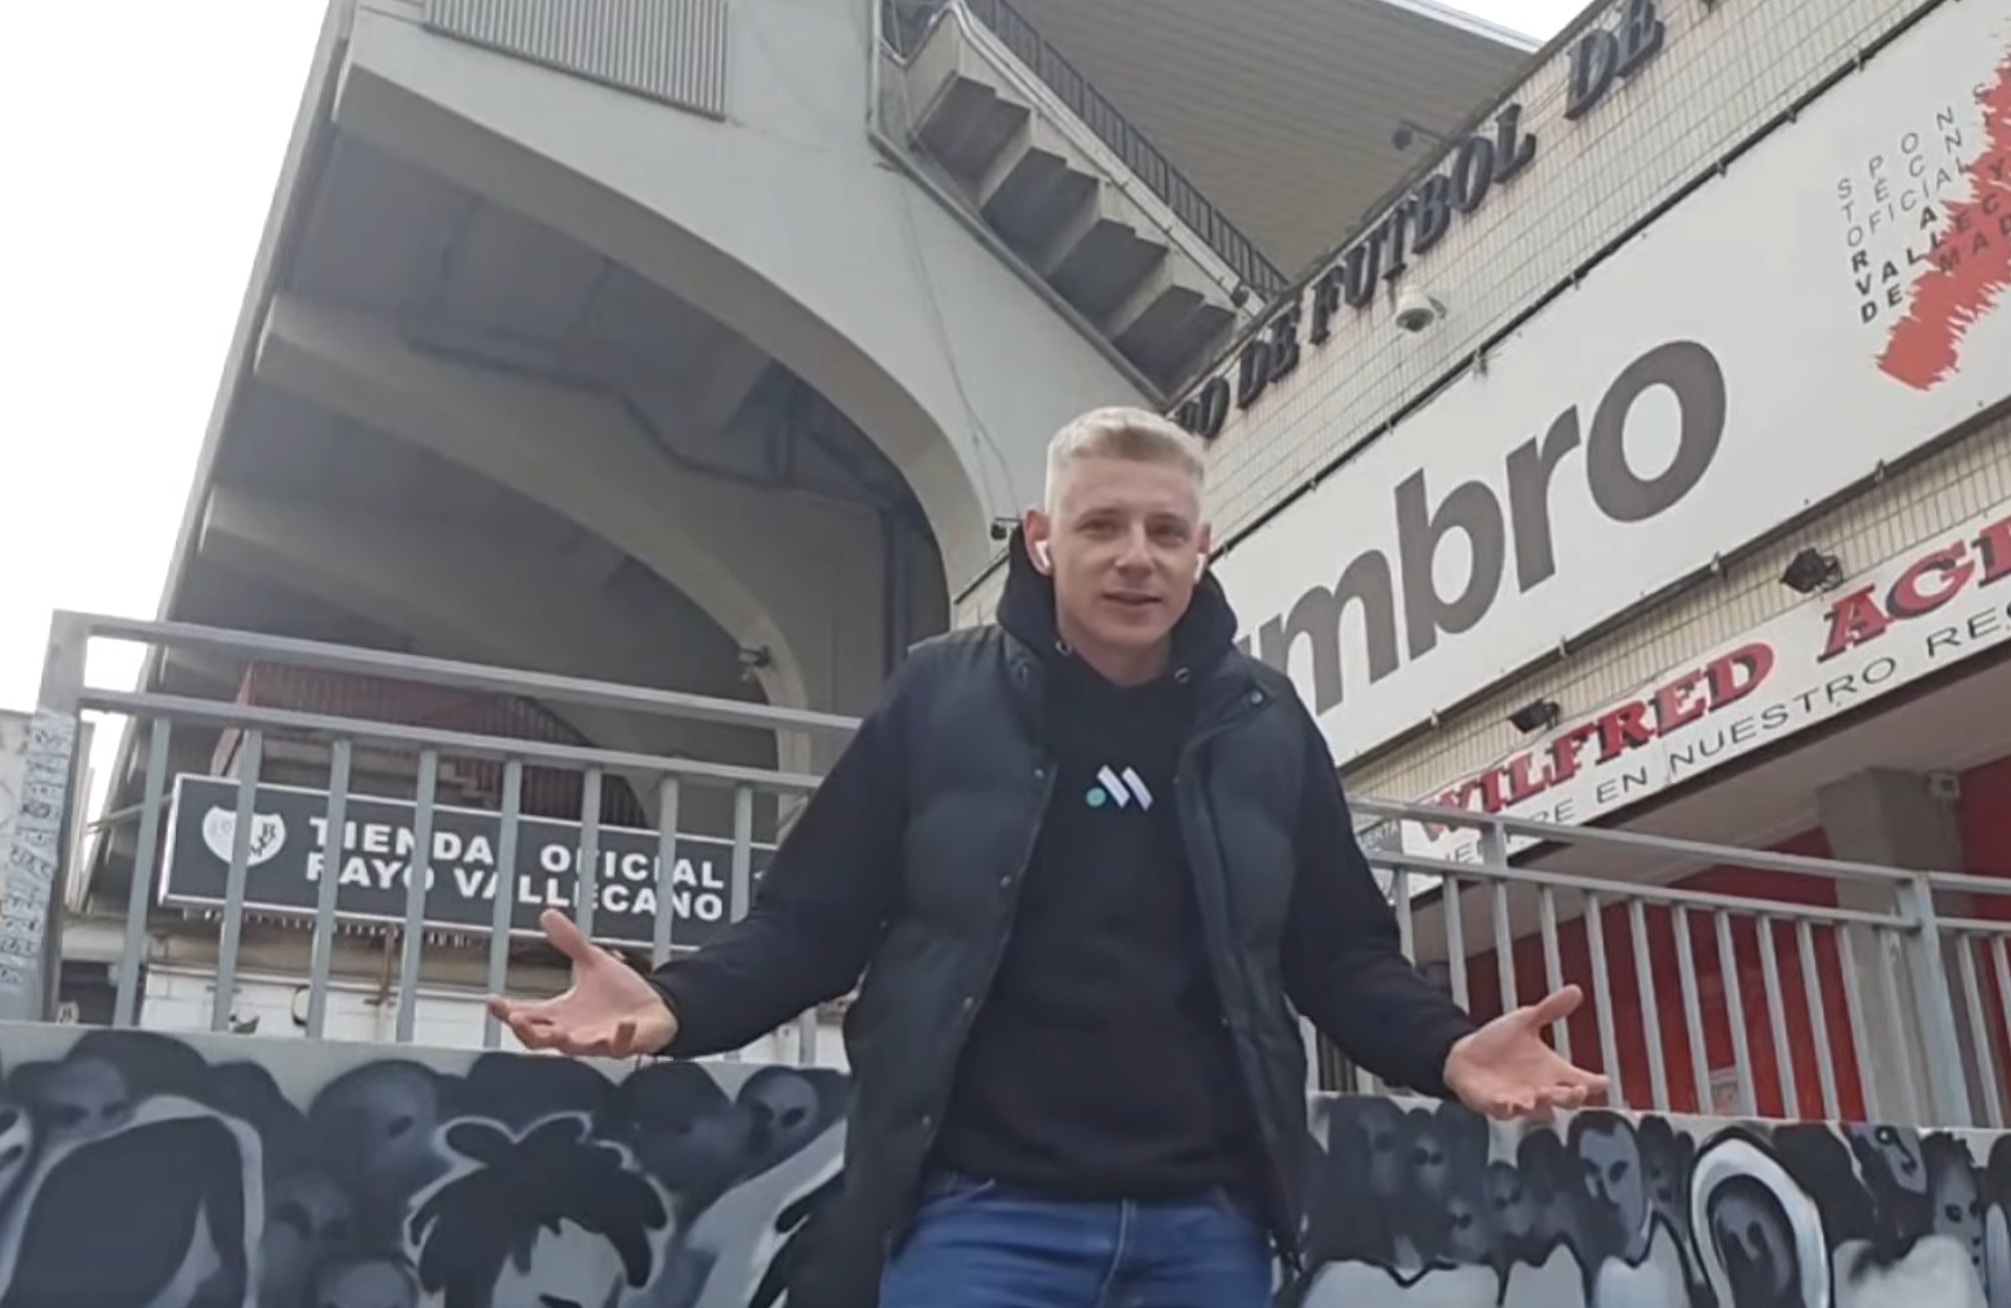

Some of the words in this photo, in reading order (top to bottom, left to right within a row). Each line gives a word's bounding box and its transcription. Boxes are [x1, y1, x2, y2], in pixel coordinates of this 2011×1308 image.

[1236, 302, 1301, 410] DE
[1308, 103, 1536, 345] FUTBOL
[1563, 0, 1666, 121] DE
[1847, 155, 1973, 249] OFICIAL
[1861, 284, 1903, 324] DE
[1236, 340, 1727, 717] mbro
[1596, 766, 1648, 803] EN
[1669, 656, 1897, 776] NUESTRO
[1925, 600, 2011, 659] RE
[309, 816, 494, 866] TIENDA
[540, 844, 725, 889] OICIAL
